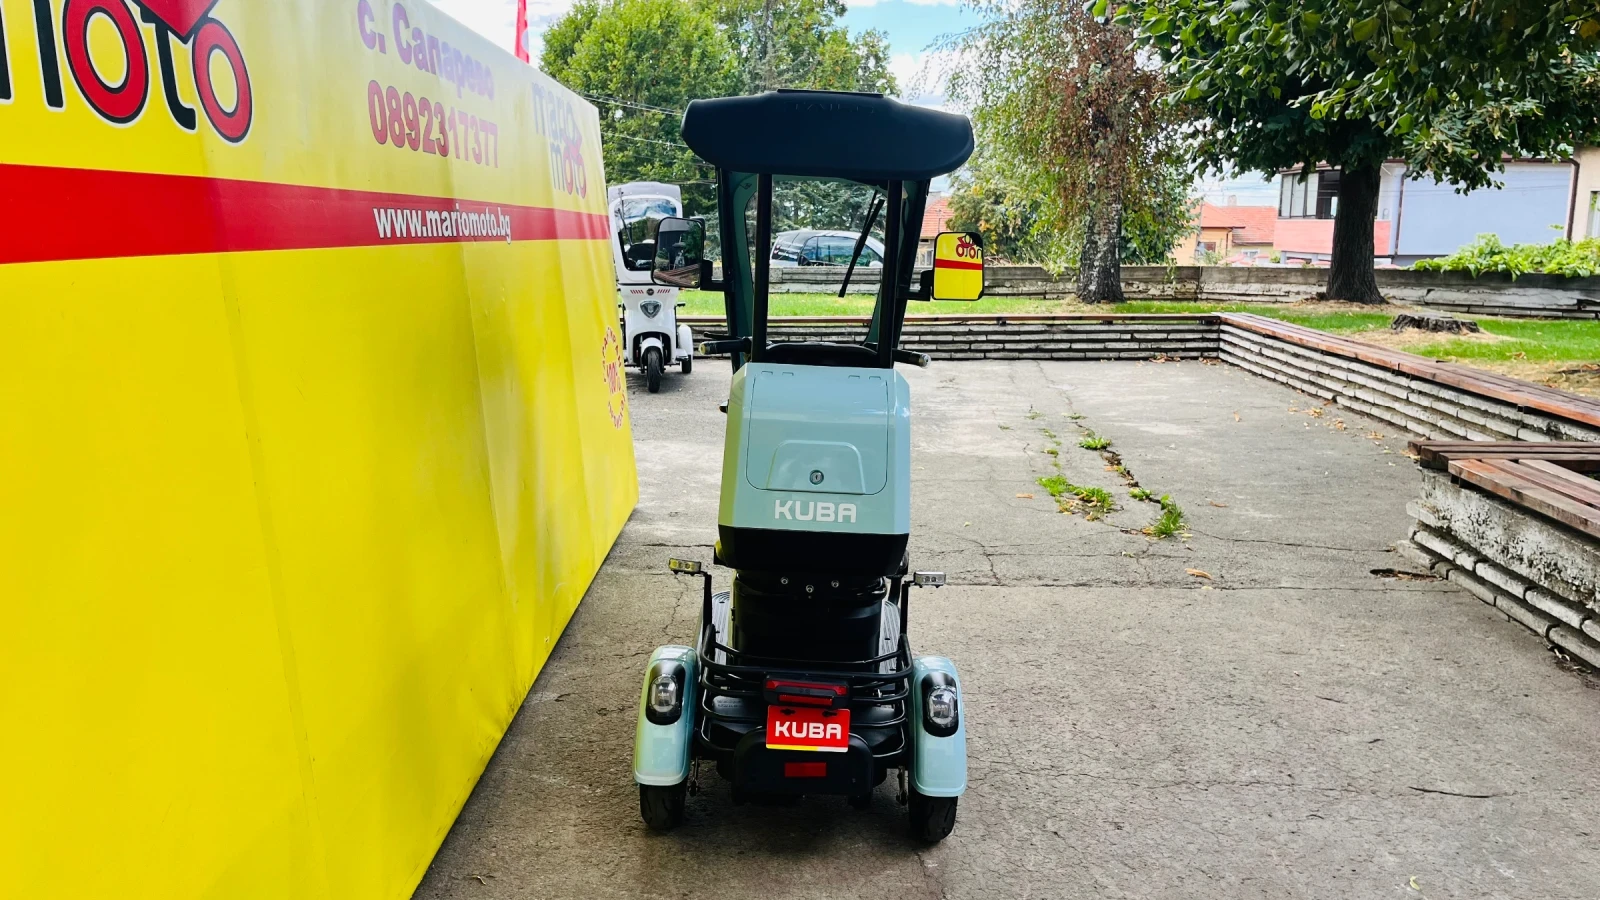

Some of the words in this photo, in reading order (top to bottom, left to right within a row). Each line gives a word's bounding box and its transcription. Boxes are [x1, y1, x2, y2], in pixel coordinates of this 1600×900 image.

[367, 79, 498, 168] 0892317377
[373, 203, 512, 244] www.mariomoto.bg
[774, 499, 857, 523] KUBA
[775, 720, 842, 740] KUBA
